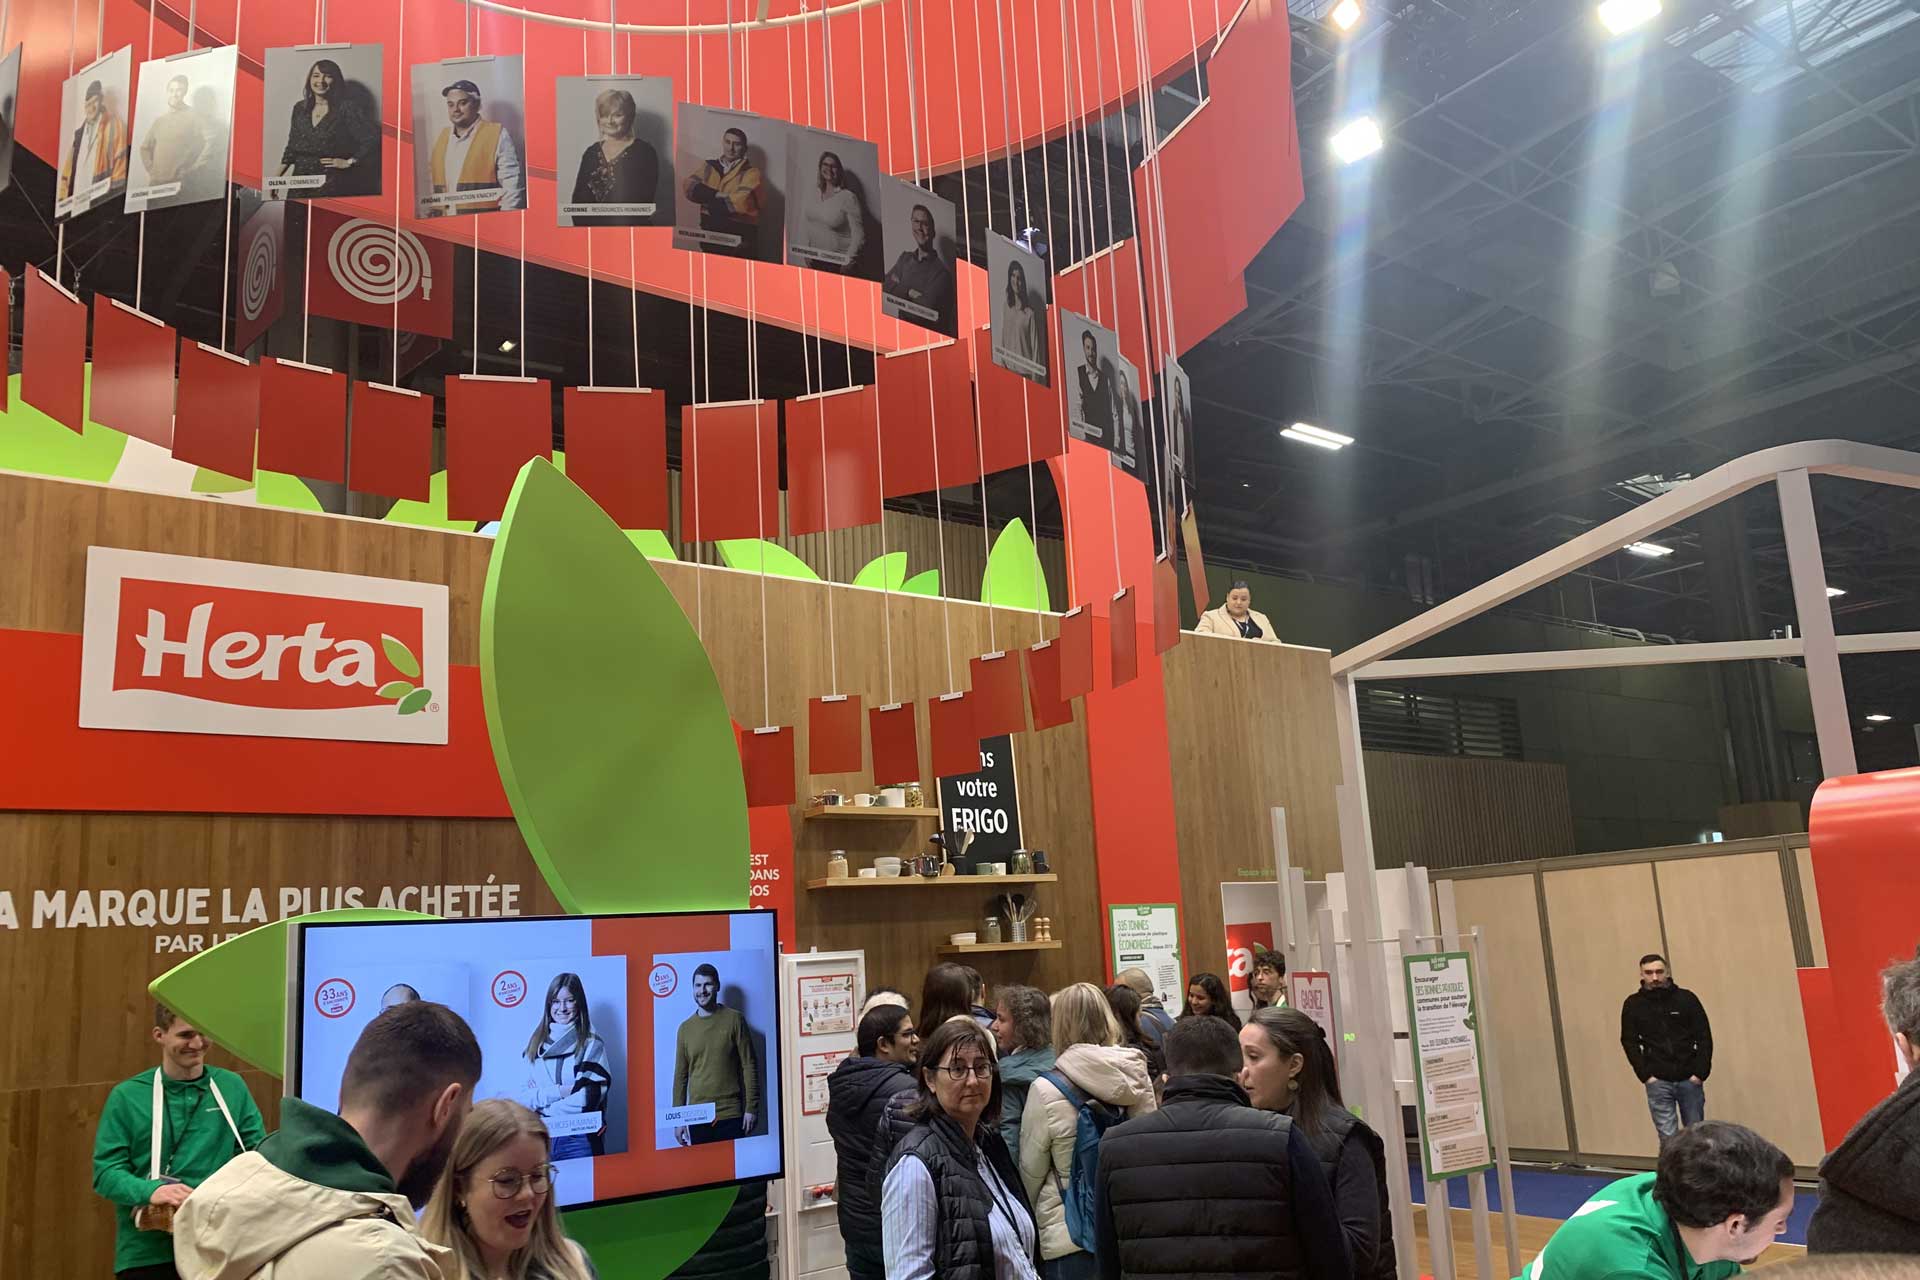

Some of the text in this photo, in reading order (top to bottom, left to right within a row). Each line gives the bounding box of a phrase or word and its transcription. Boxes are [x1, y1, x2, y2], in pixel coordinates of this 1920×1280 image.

[135, 602, 377, 688] Herta
[957, 779, 997, 797] votre
[952, 808, 1008, 834] FRIGO
[32, 888, 210, 929] MARQUE
[222, 887, 268, 924] LA
[376, 873, 520, 917] ACHETÉE
[155, 934, 203, 953] PAR
[1414, 976, 1438, 984] Encourager
[665, 1111, 681, 1120] LOUIS
